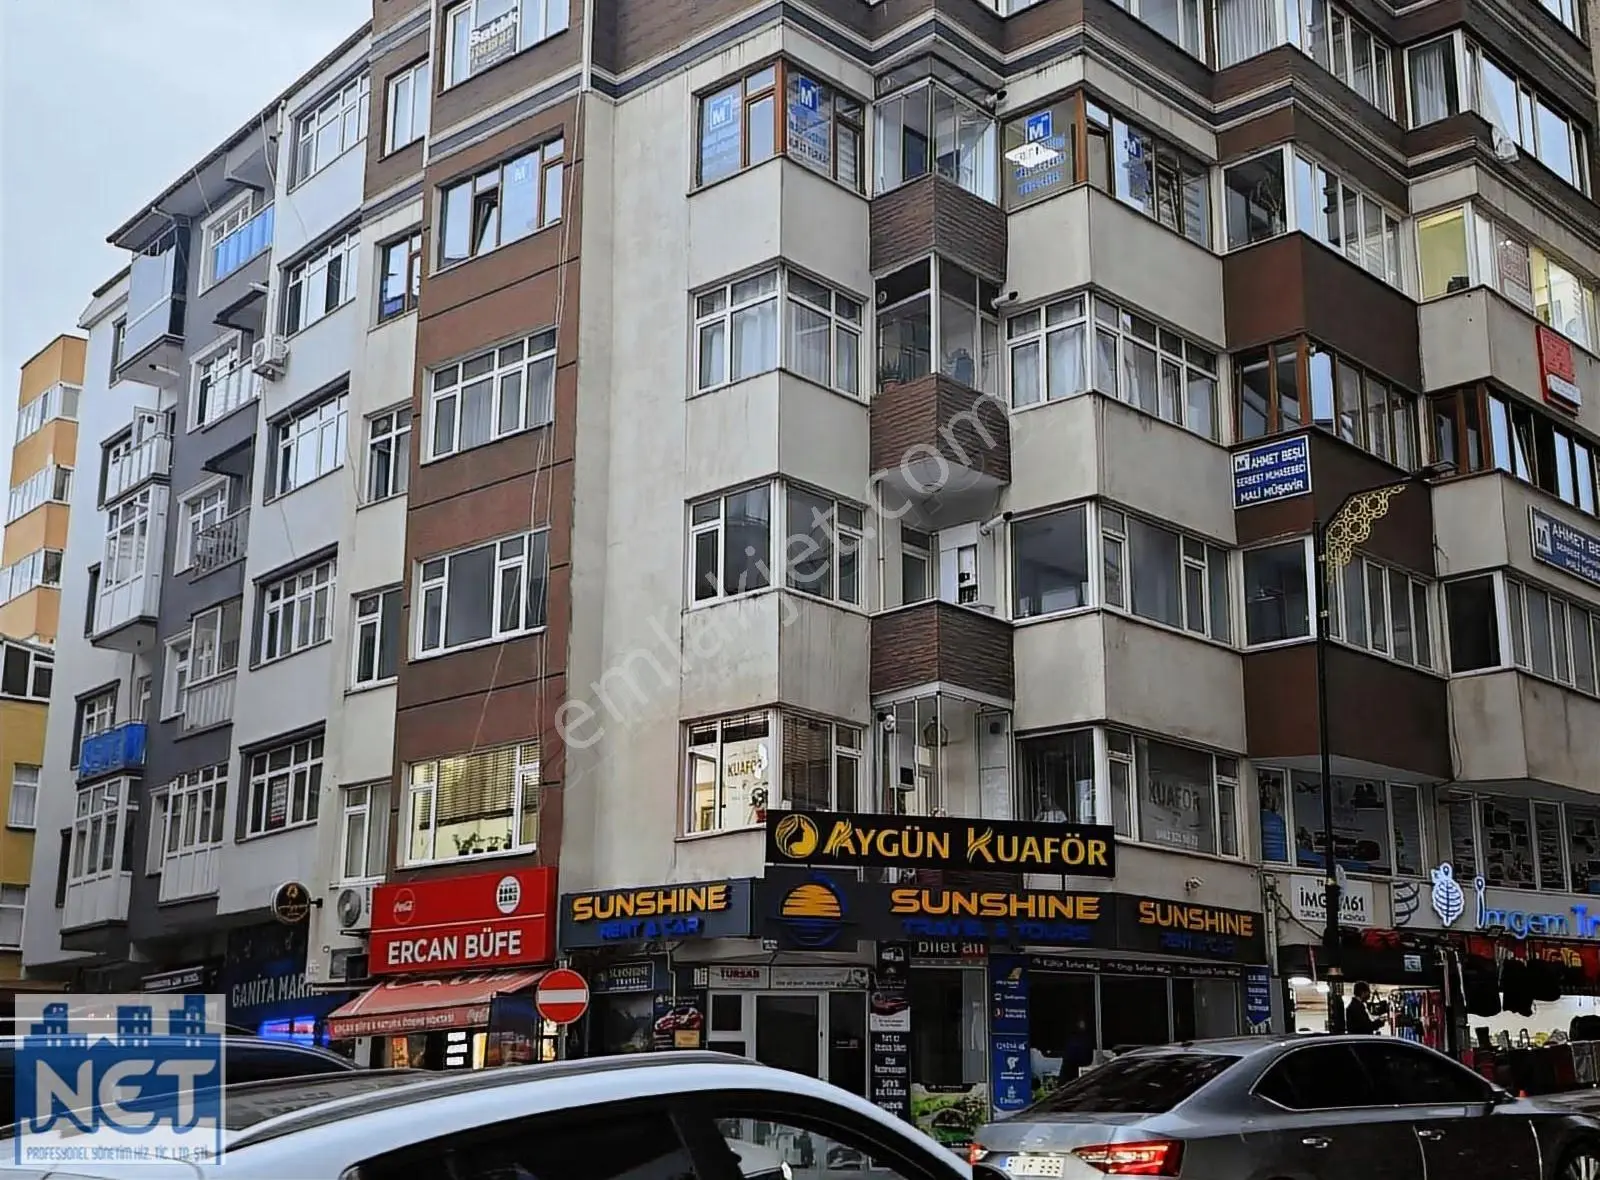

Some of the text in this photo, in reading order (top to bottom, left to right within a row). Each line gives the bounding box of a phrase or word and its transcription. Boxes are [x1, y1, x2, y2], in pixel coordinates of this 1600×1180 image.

[1251, 452, 1279, 469] AHMET
[1552, 523, 1585, 549] AHMET
[823, 819, 1108, 867] AYGÜN KUAFÖR
[573, 885, 728, 921] SUNSHINE
[891, 889, 1101, 920] SUNSHINE
[1139, 901, 1254, 937] SUNSHINE
[387, 927, 523, 966] ERCAN BÜFE
